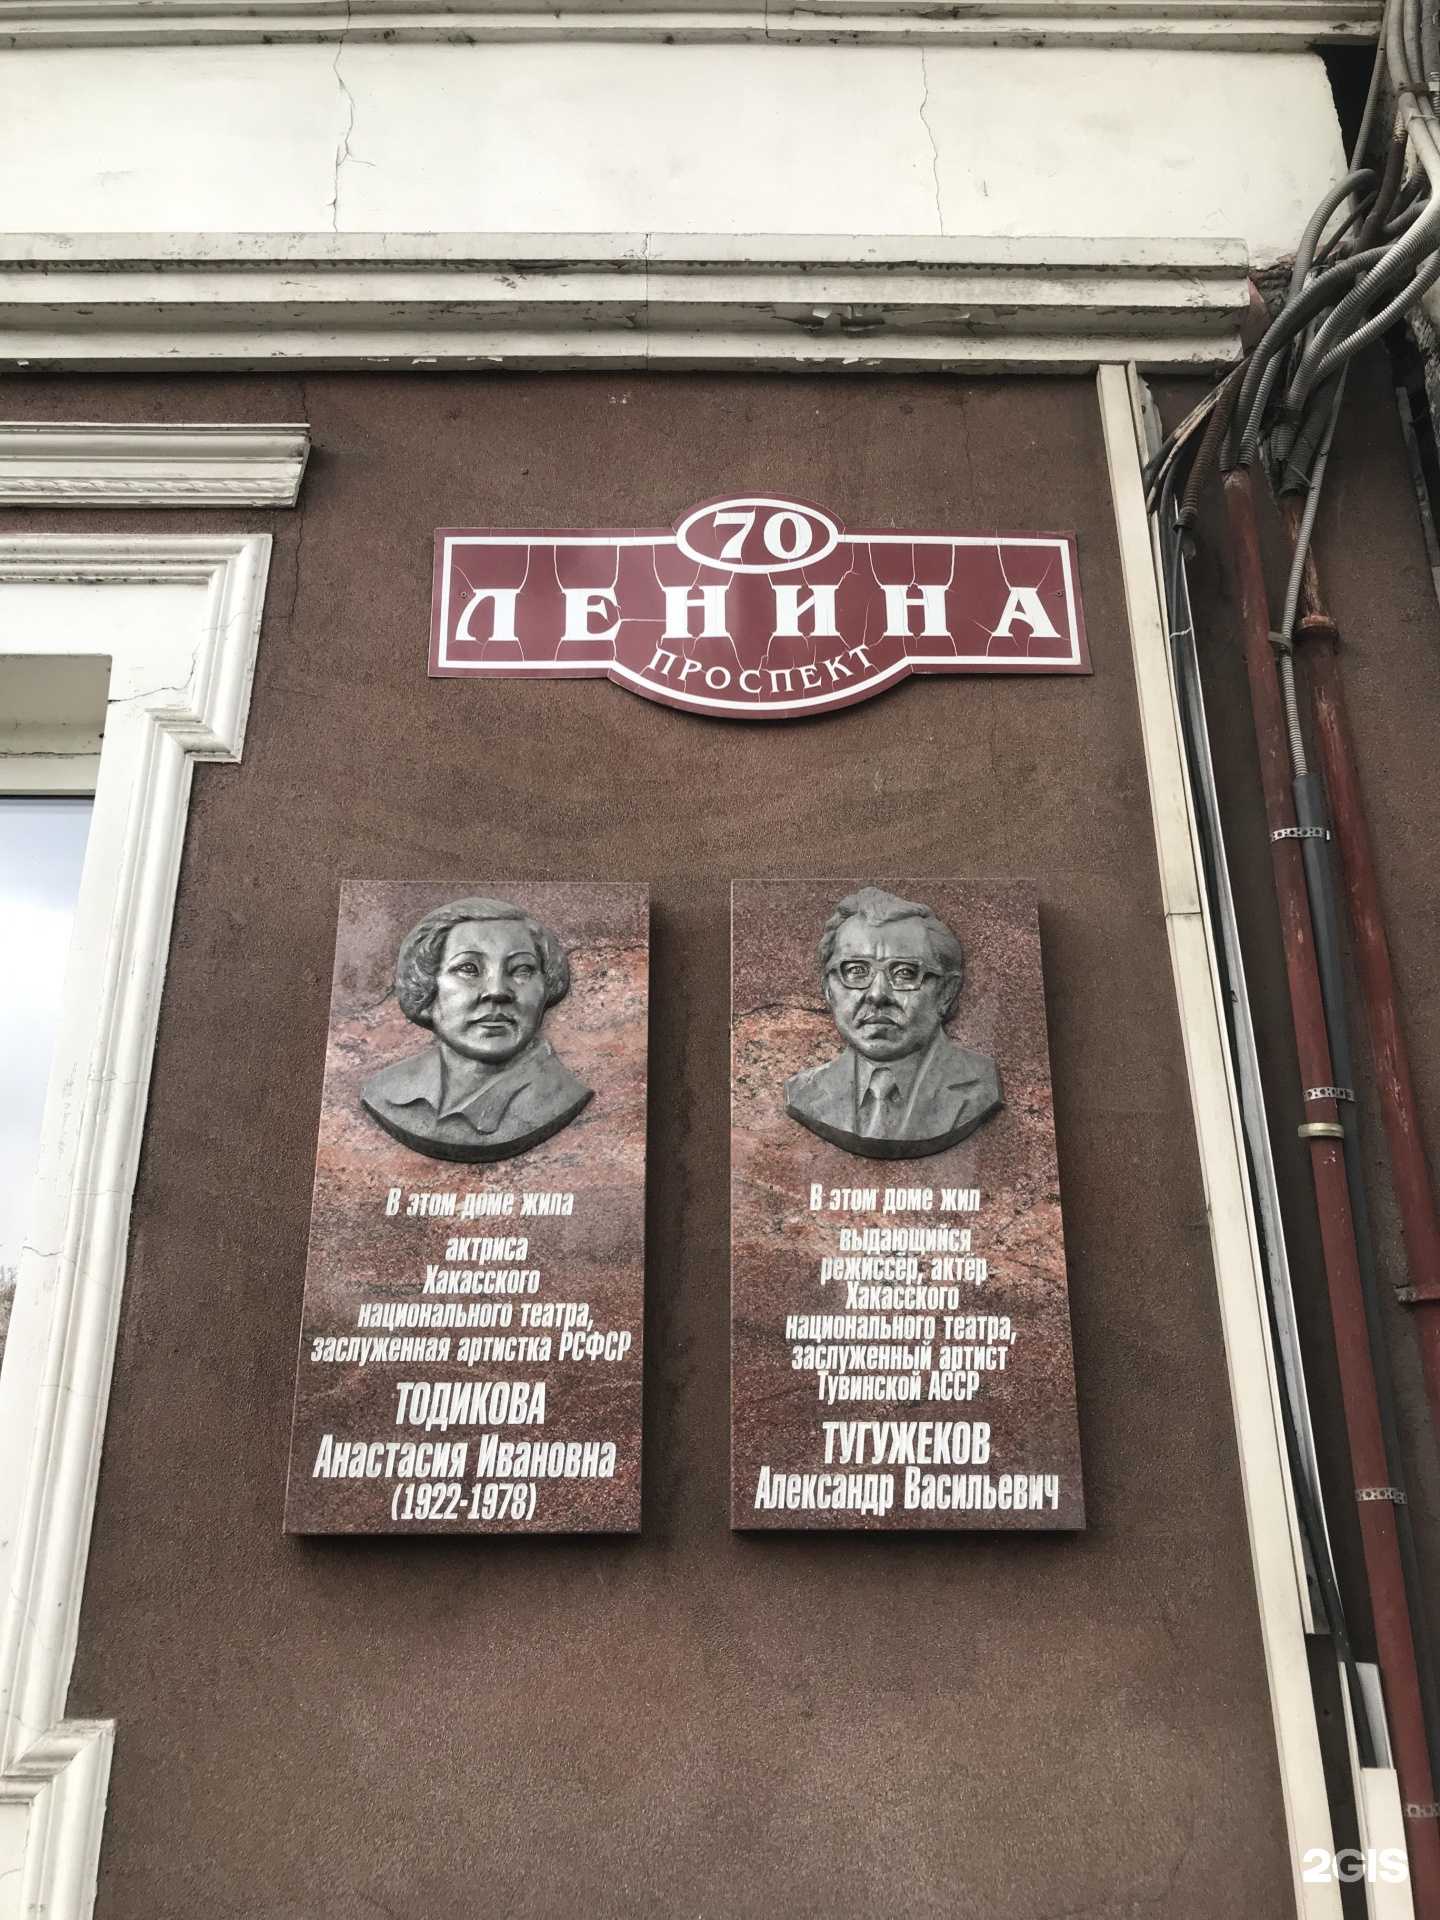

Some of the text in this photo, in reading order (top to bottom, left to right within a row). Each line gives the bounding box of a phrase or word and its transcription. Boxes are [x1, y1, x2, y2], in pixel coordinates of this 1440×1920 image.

[712, 511, 813, 560] 70
[455, 584, 1062, 641] ЛЕНИНА
[649, 644, 876, 693] ПРОСПЕКТ
[386, 1187, 574, 1220] В этом доме жила
[810, 1183, 980, 1215] В этом доме жил
[445, 1237, 529, 1265] актриса
[839, 1224, 971, 1254] выдающийся
[422, 1265, 540, 1295] Хакасского
[821, 1253, 988, 1285] режиссёр, актёр
[845, 1281, 959, 1310] Хакасского
[358, 1302, 594, 1332] национального театра,
[786, 1315, 1017, 1344] национального театра,
[310, 1330, 632, 1367] заслуженная артистка РСФСР
[792, 1341, 1008, 1373] заслуженный артист
[818, 1370, 980, 1405] Тувинской АССР
[395, 1382, 546, 1431] ТОДИКОВА
[312, 1434, 617, 1478] Анастасия Ивановна
[822, 1421, 991, 1465] ТУГУЖЕКОВ
[391, 1483, 537, 1521] (1922-1978)
[754, 1465, 1059, 1516] Александр Васильевич
